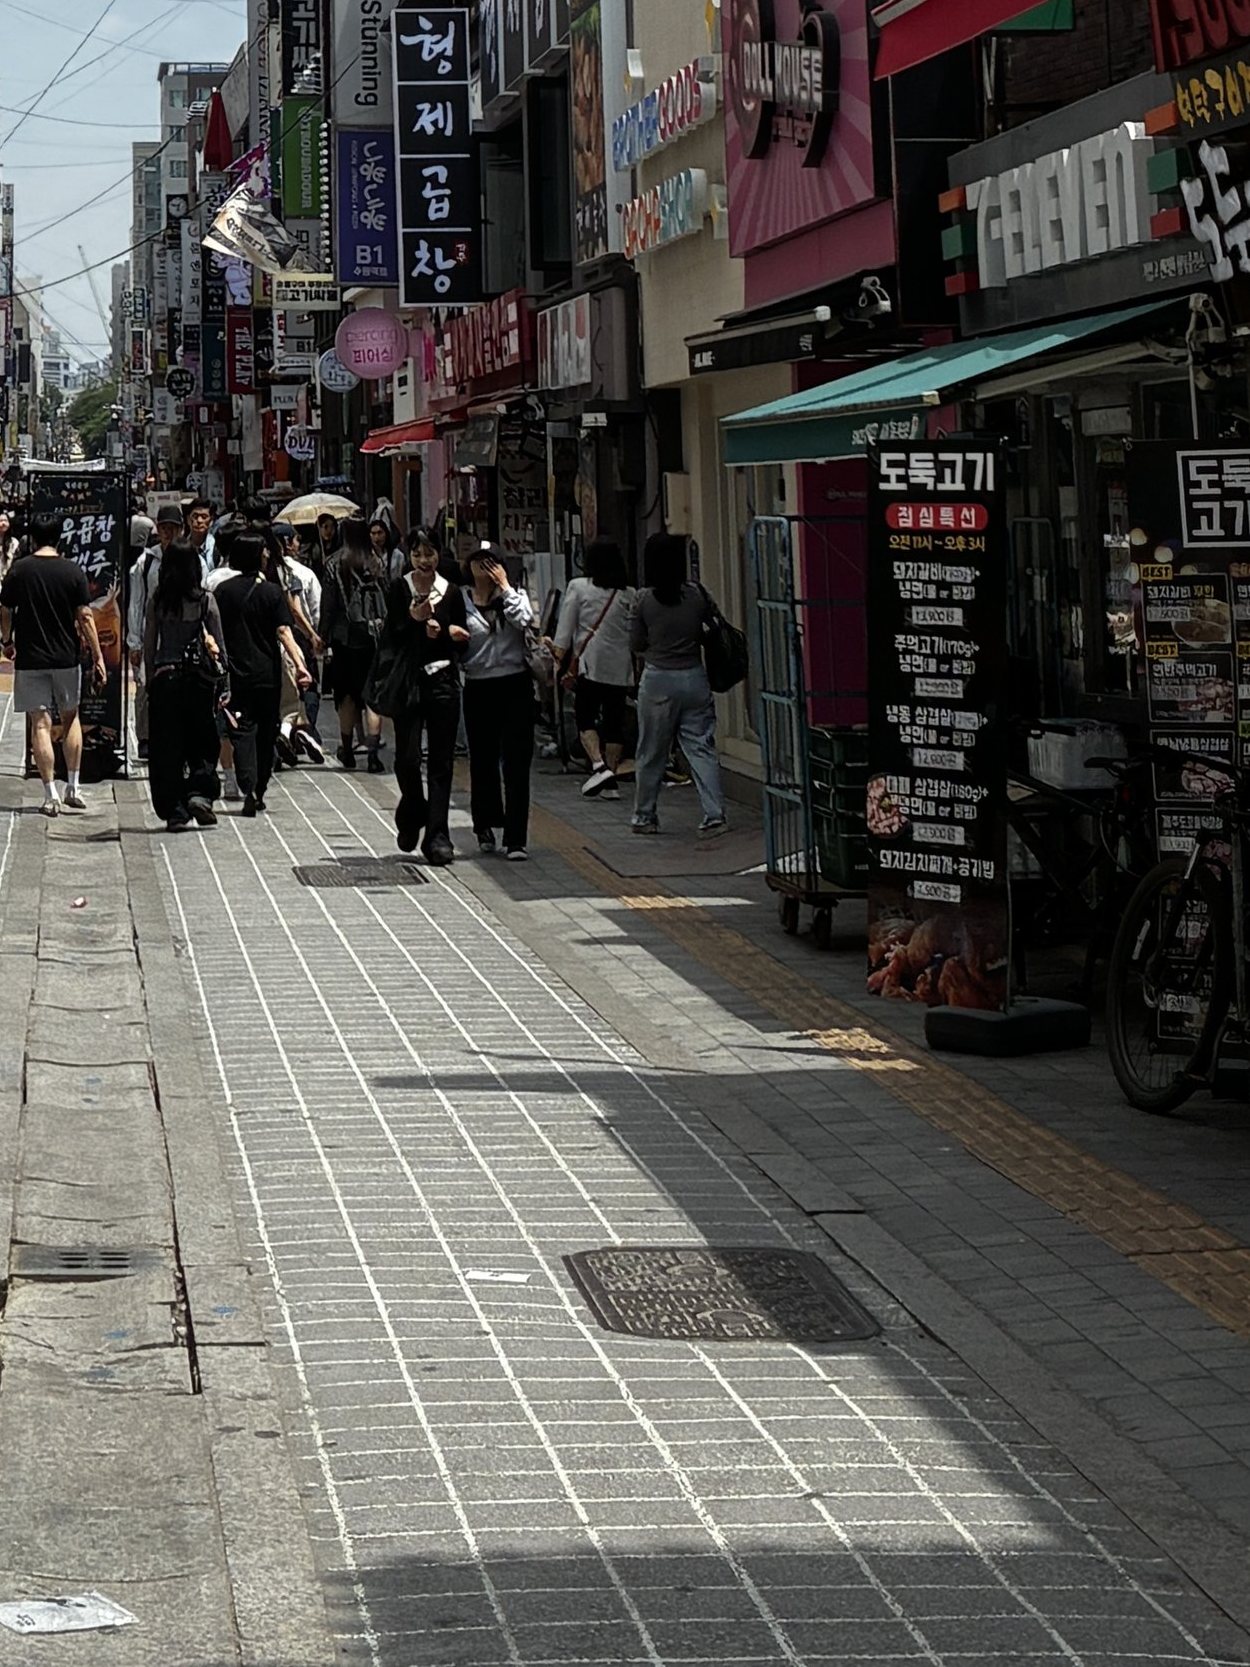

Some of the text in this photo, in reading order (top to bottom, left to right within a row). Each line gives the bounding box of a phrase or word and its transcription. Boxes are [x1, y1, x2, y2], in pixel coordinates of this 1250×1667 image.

[361, 0, 379, 107] Stunning
[742, 41, 823, 113] DOLL HOUSE
[658, 58, 703, 143] GOODS
[401, 15, 456, 294] 형제곱창
[356, 245, 383, 264] B1
[353, 347, 393, 364] 피어싱
[878, 452, 995, 492] 도둑고기
[898, 506, 976, 528] 점심특선
[889, 535, 910, 550] 오전
[968, 535, 986, 552] 3시
